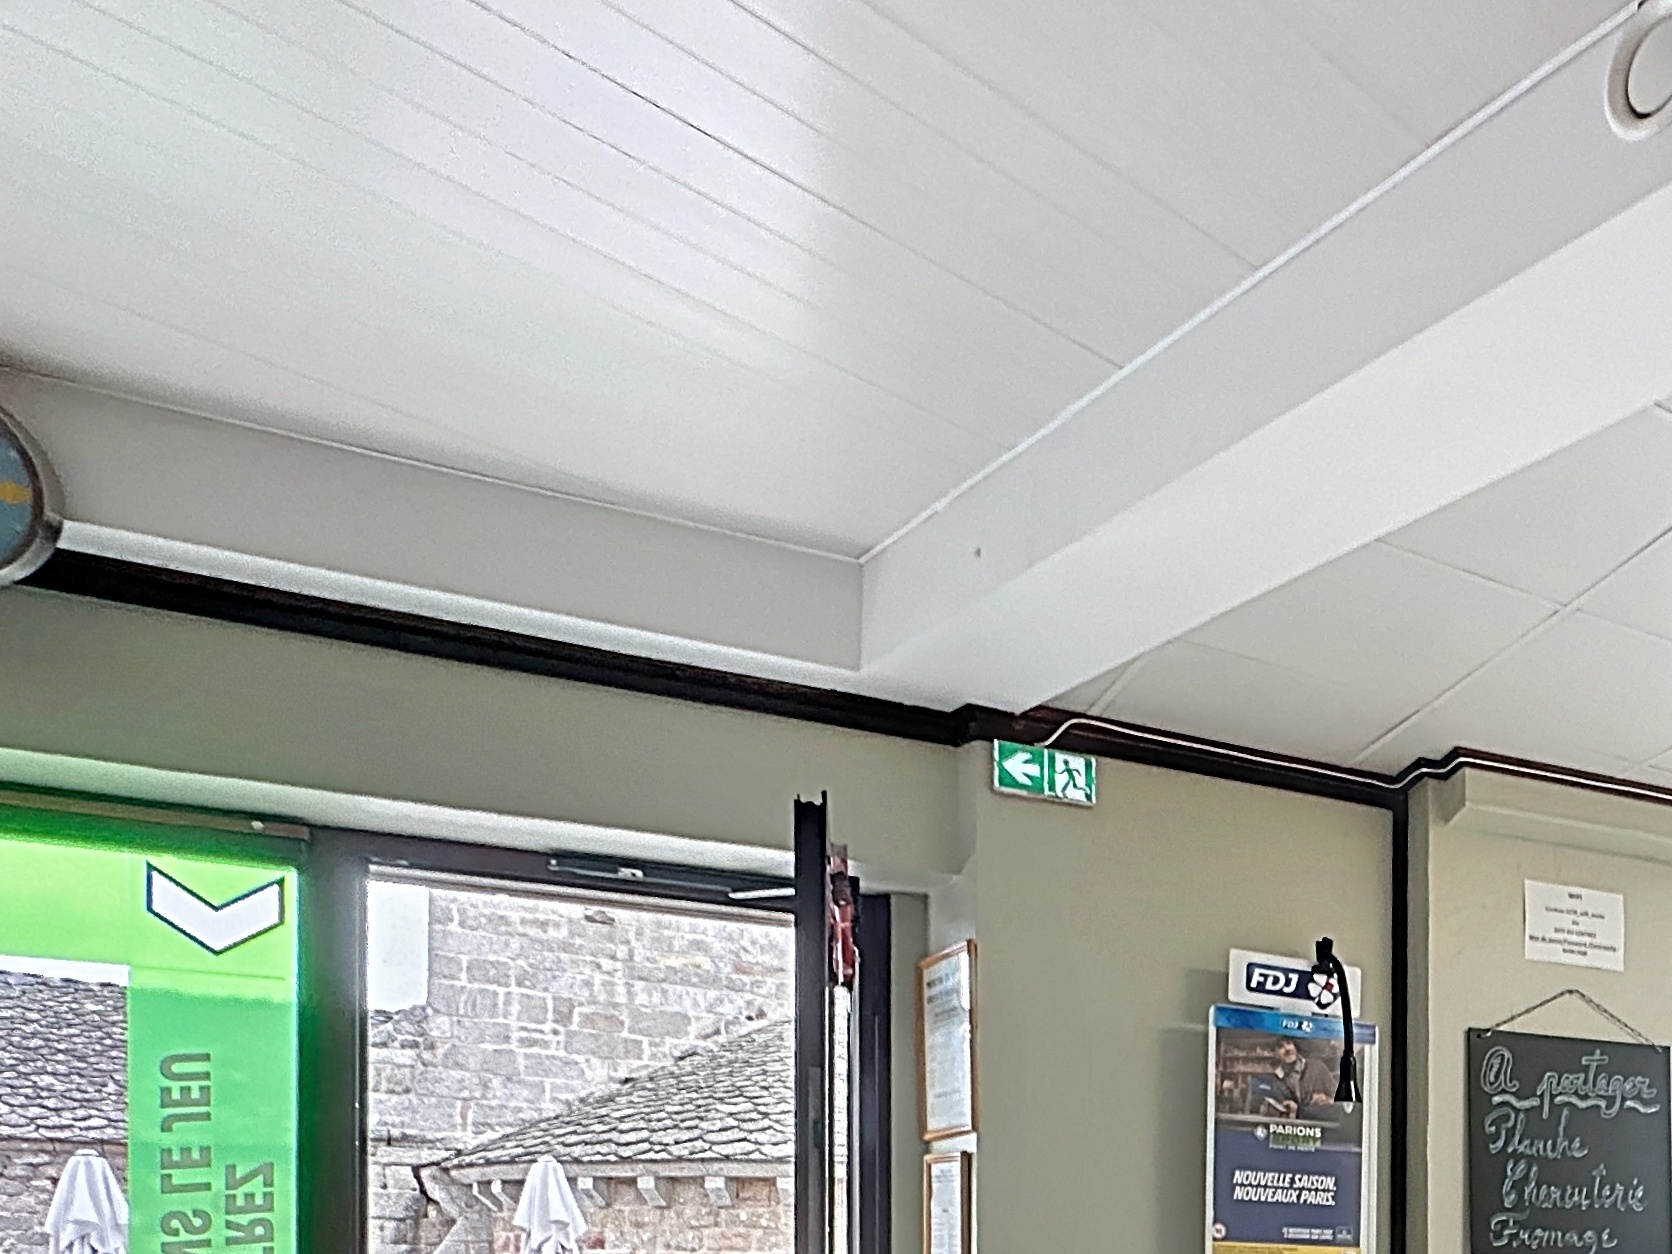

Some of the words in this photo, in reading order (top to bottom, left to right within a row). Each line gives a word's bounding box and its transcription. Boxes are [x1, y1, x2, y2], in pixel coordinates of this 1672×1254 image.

[1249, 967, 1300, 996] FDJ
[1536, 1048, 1658, 1119] partager
[1269, 1123, 1322, 1138] PARIONS
[1484, 1106, 1590, 1160] Planche
[1233, 1169, 1292, 1188] NOUVELLE
[1293, 1173, 1337, 1191] SAISON.
[1233, 1186, 1299, 1205] NOUVEAUX
[1299, 1189, 1336, 1207] PARIS.
